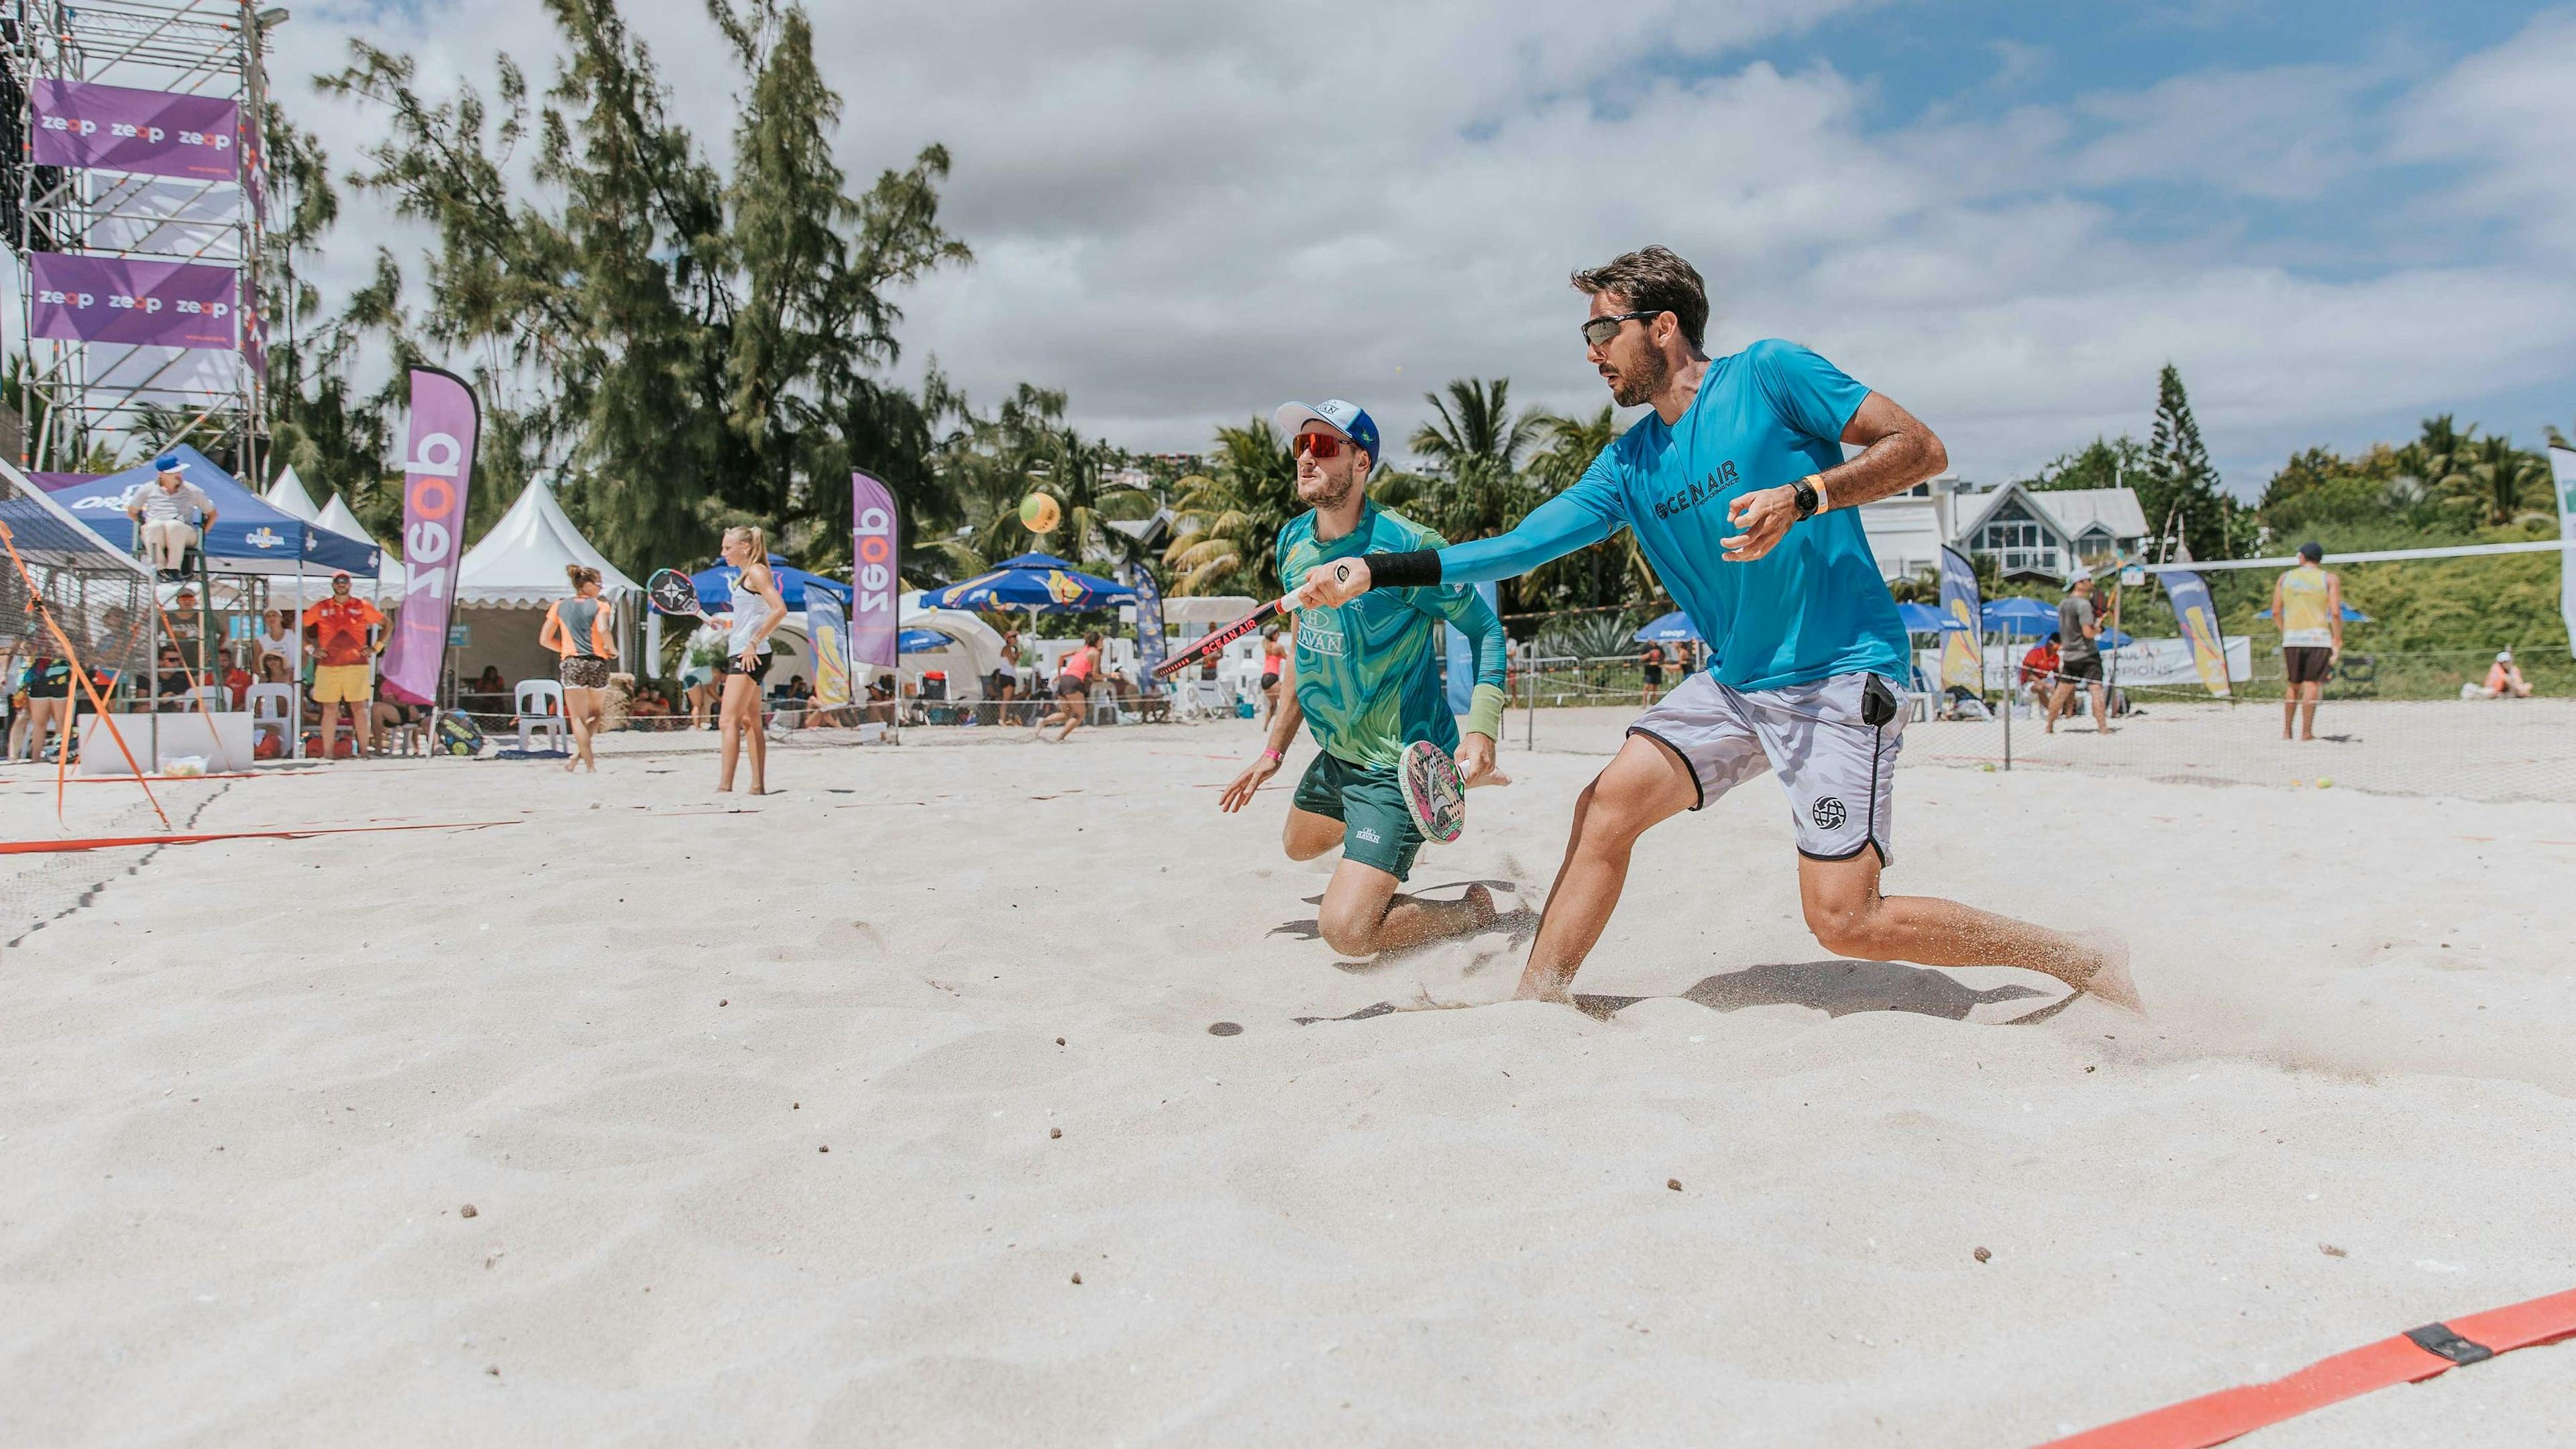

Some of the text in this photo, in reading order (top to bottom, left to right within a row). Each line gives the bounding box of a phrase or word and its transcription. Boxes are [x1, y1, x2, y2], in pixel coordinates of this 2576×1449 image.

[42, 115, 231, 151] zeop zeop zeop
[39, 290, 229, 319] zeop zeop zeop
[1655, 460, 1738, 520] OCEN AIR
[1697, 477, 1739, 507] PERFORMANCE
[1240, 619, 1257, 634] AIR
[1356, 831, 1380, 843] HAVAN
